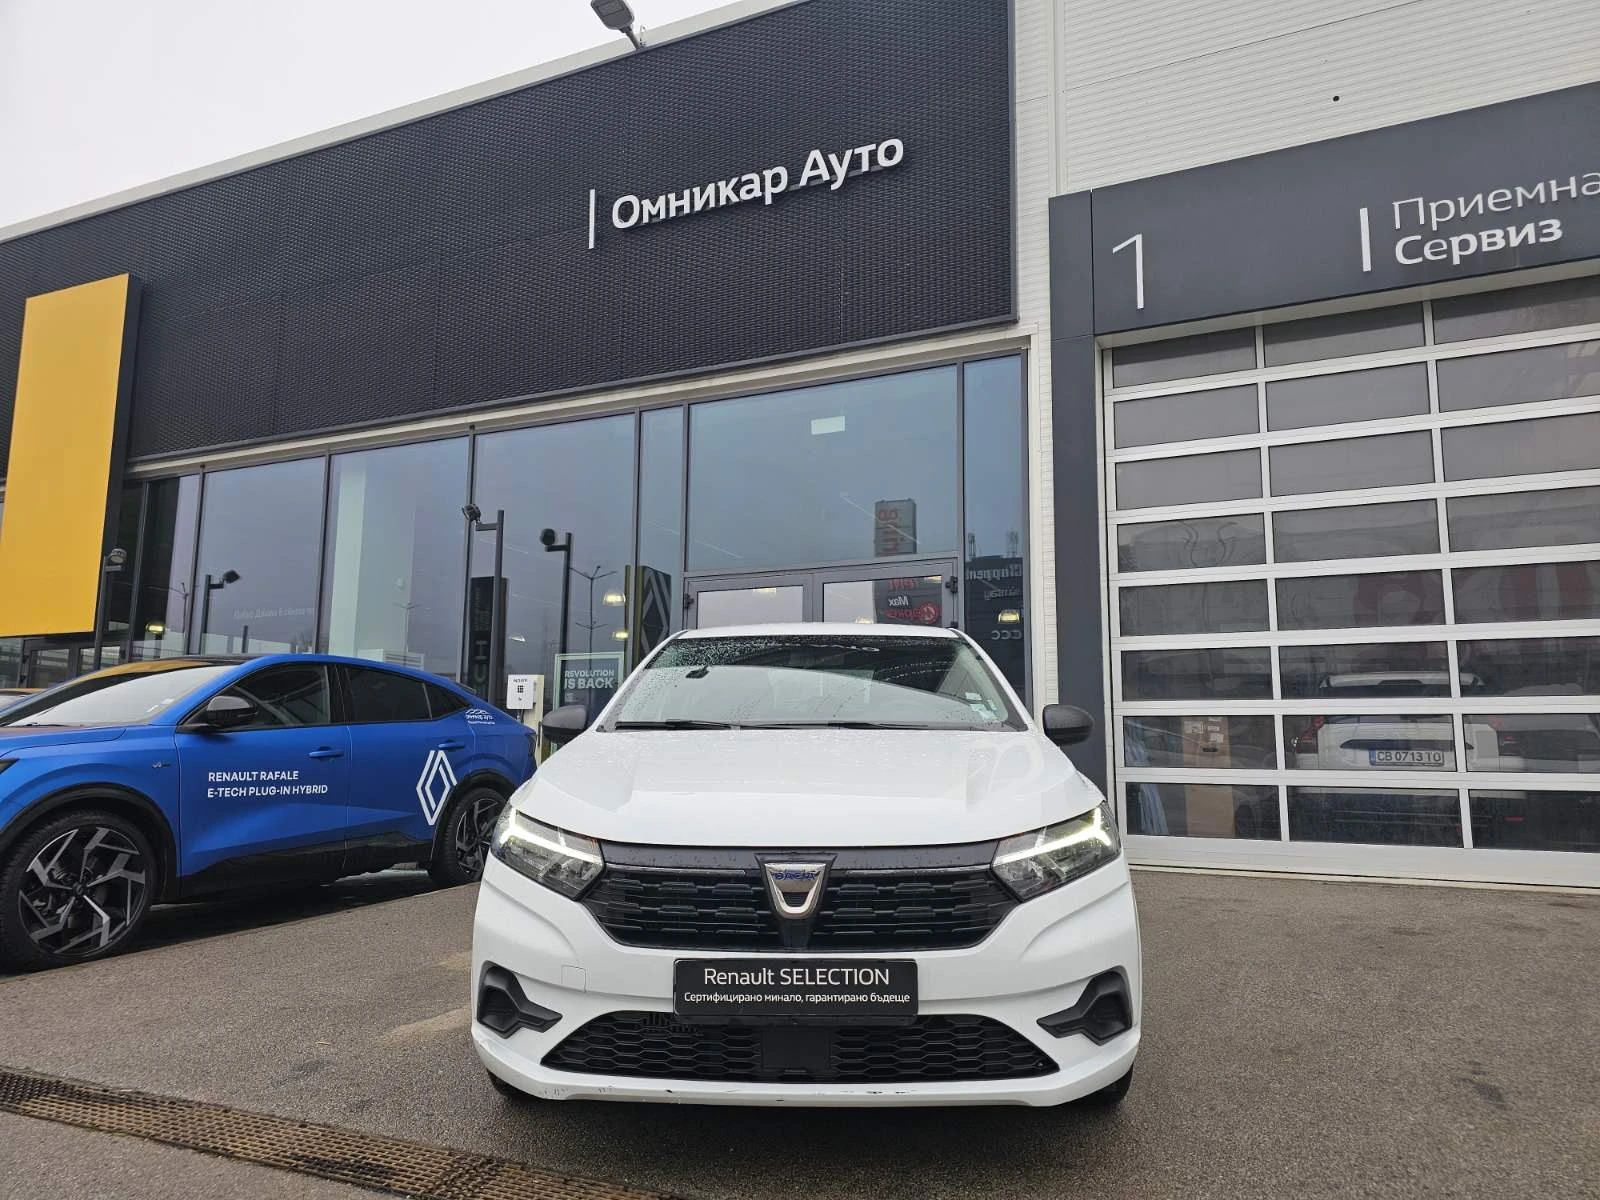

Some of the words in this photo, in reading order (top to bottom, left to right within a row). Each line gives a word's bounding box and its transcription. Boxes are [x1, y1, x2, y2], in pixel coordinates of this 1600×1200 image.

[612, 166, 788, 229] Омникар
[799, 138, 904, 190] Ауто
[1393, 171, 1600, 232] Приемна
[1395, 218, 1564, 265] Сервиз
[1112, 232, 1144, 310] 1
[564, 669, 615, 678] REVOLUTION
[563, 678, 576, 690] IS
[577, 677, 614, 690] BACK
[208, 771, 258, 782] RENAULT
[260, 770, 300, 781] RAFALE
[207, 787, 247, 798] E-TECH
[248, 785, 291, 796] PLUG-IN
[292, 784, 328, 795] HYBRID
[704, 967, 775, 986] Renault
[780, 967, 890, 986] SELECTION
[684, 991, 763, 1003] Сертифицирано
[764, 993, 804, 1004] минало,
[805, 993, 869, 1004] гарантирано
[870, 991, 911, 1003] бъдеще
